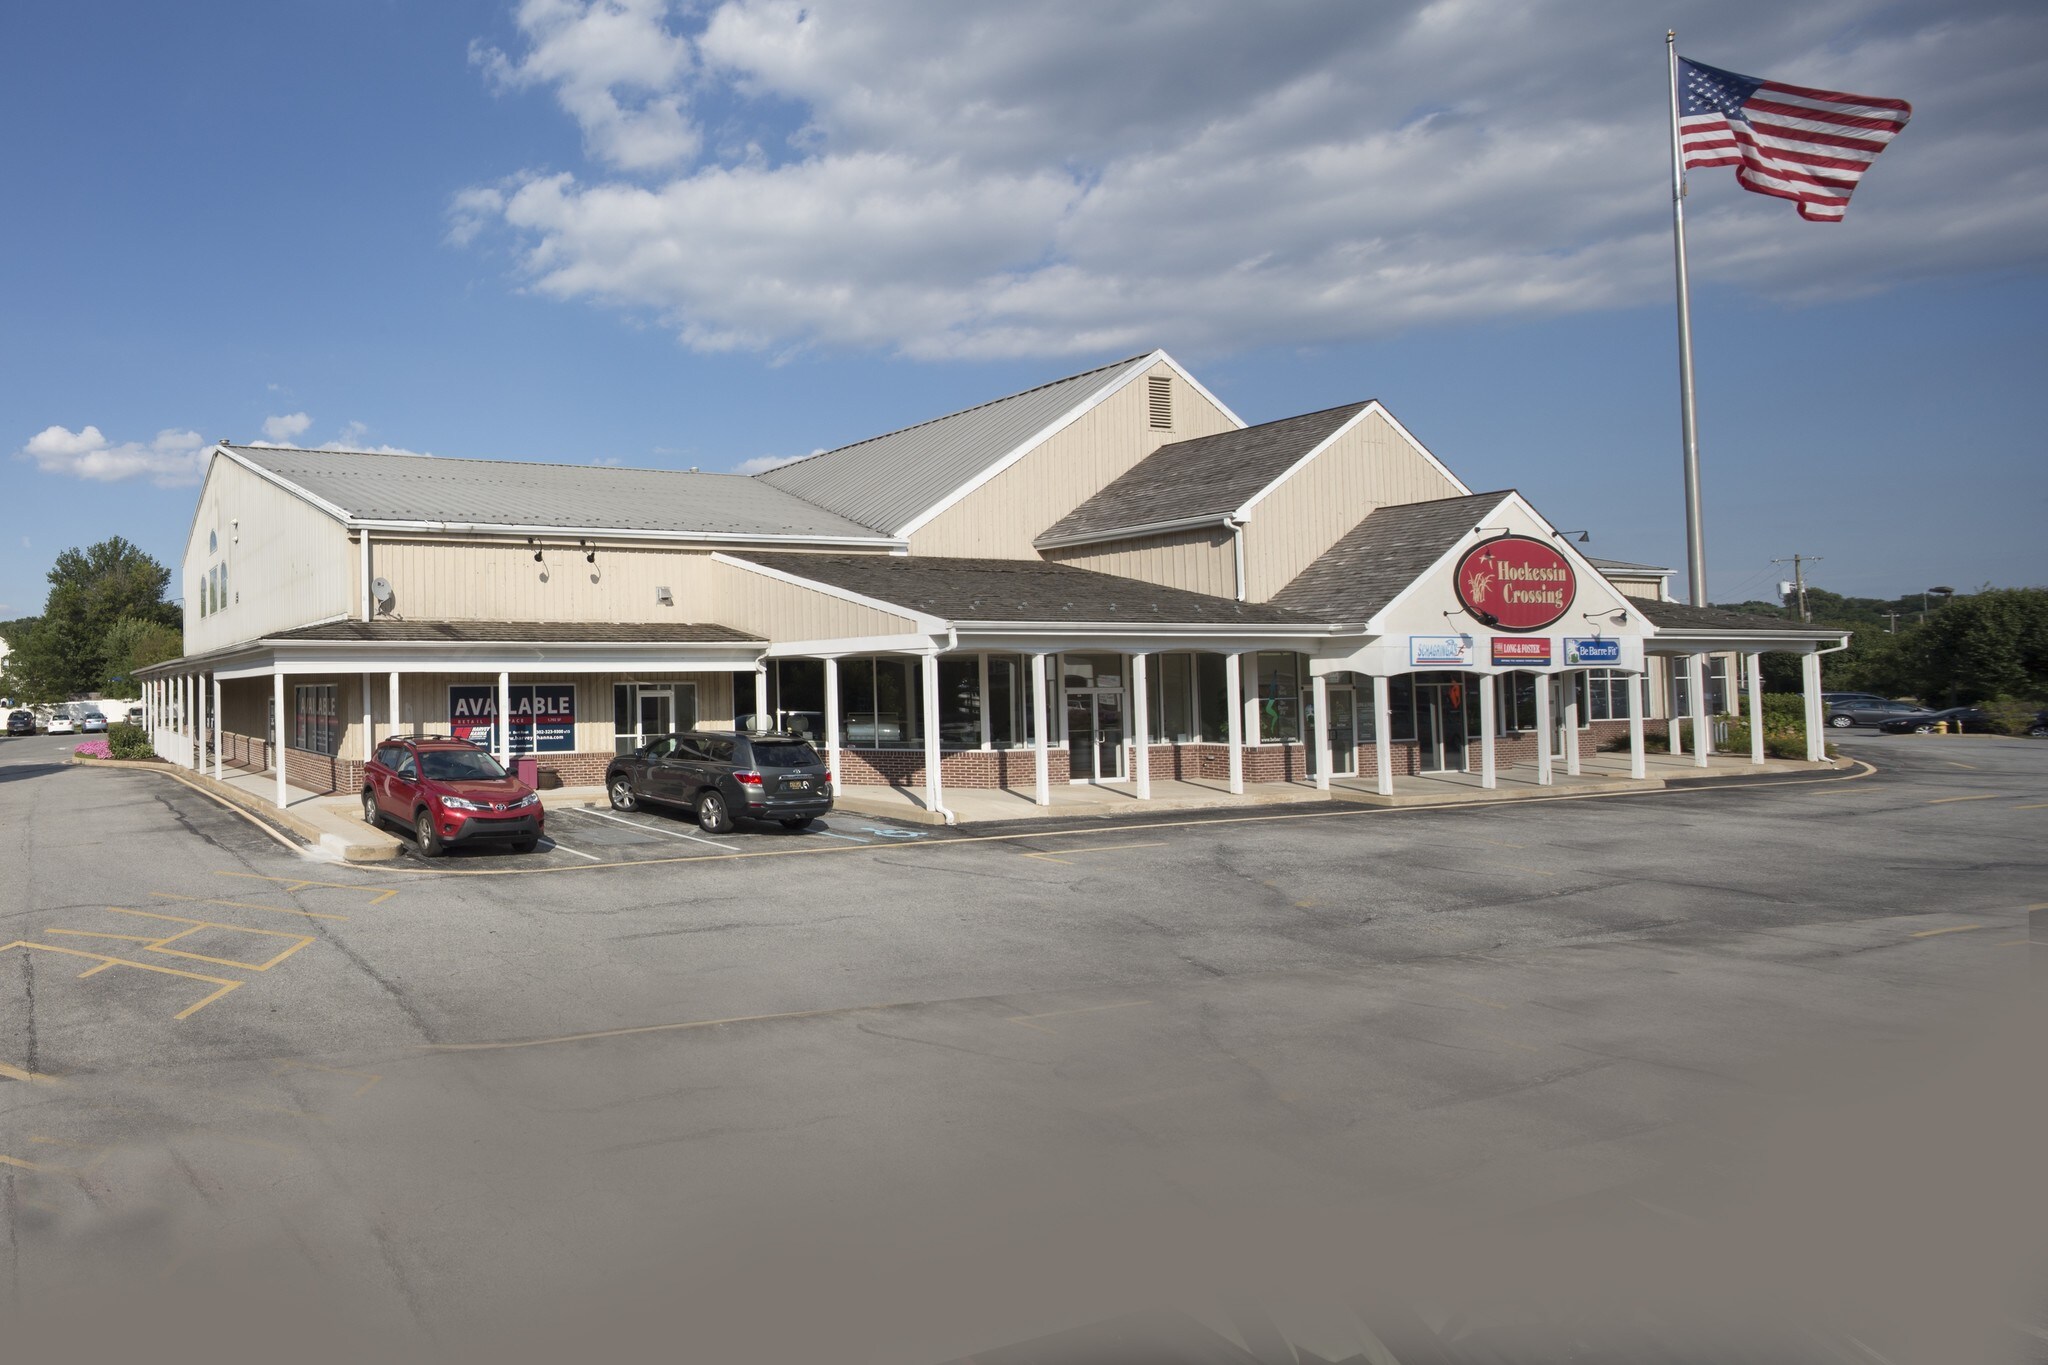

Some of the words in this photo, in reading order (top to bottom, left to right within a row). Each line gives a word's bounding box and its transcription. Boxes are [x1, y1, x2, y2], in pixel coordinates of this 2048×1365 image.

[1496, 560, 1567, 581] Hockessin
[1503, 583, 1563, 608] Crossing
[1503, 643, 1517, 653] LONG
[1517, 644, 1522, 653] &
[1522, 643, 1541, 653] FOSTER
[1580, 646, 1589, 656] Be
[1589, 646, 1607, 656] Barre
[1608, 646, 1617, 656] Fit
[455, 696, 570, 716] AVALABLE
